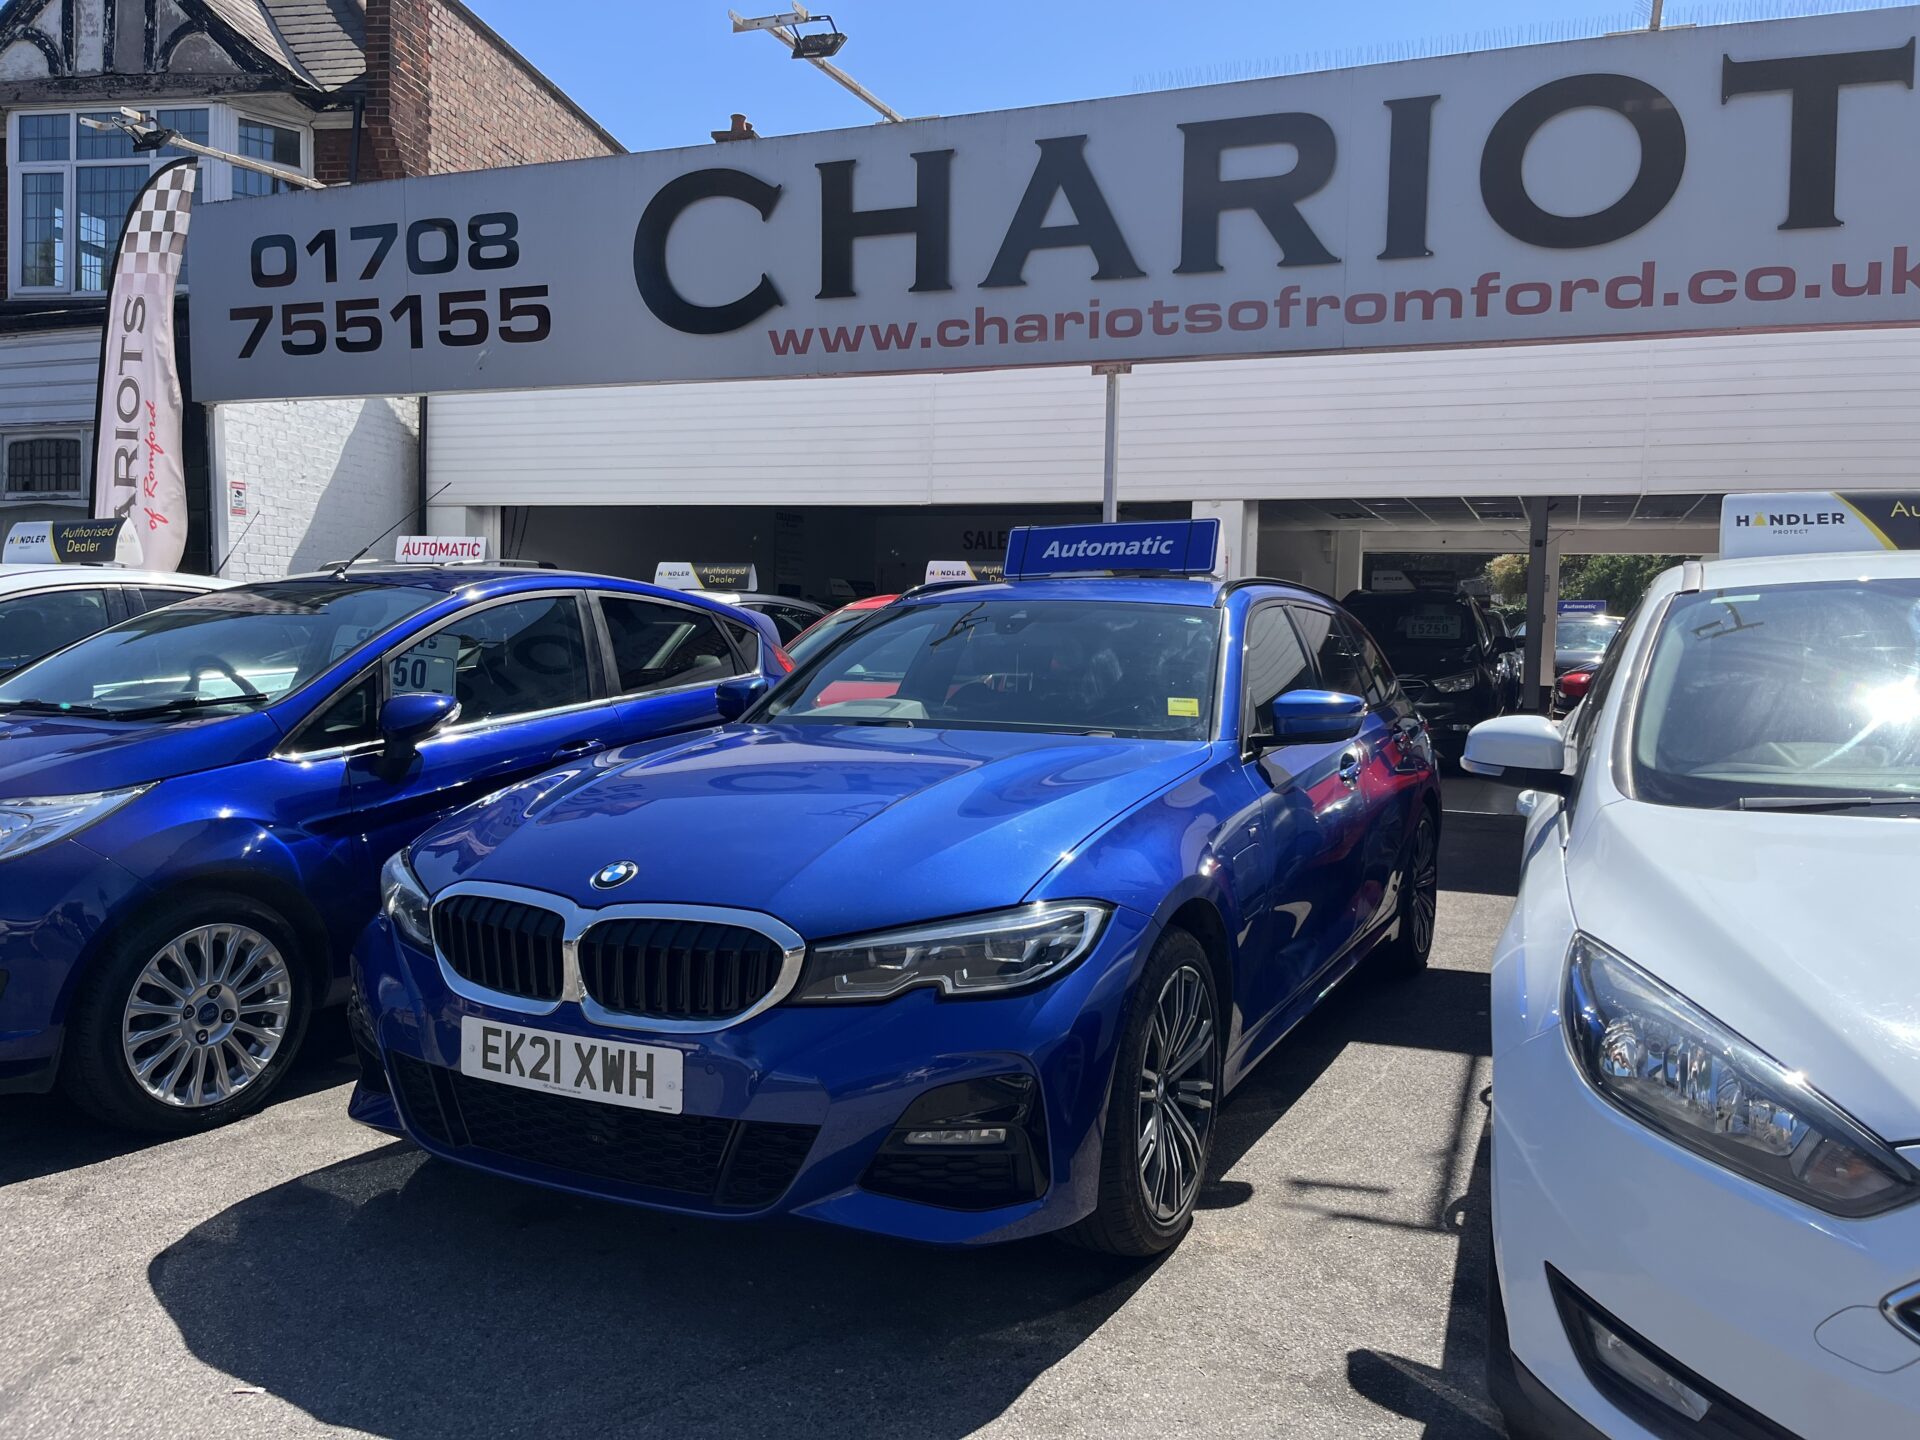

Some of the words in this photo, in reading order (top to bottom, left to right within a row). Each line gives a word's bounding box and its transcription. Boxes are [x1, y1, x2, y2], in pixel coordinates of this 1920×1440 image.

[633, 35, 1917, 335] CHARIOT
[250, 211, 520, 289] 01708
[768, 245, 1920, 356] www.chariotsofromford.co.uk
[229, 284, 552, 360] 755155
[113, 294, 146, 520] ARIOTS
[143, 400, 165, 498] Romford
[60, 523, 118, 539] Authorised
[1735, 511, 1846, 527] HANDLER
[8, 535, 47, 545] HANDLER
[66, 539, 101, 553] Dealer
[401, 542, 481, 557] AUTOMATIC
[1041, 535, 1174, 559] Automatic
[702, 566, 747, 575] Authorised
[708, 574, 737, 584] Dealer
[482, 1025, 561, 1085] EK21
[573, 1041, 655, 1100] XWH
